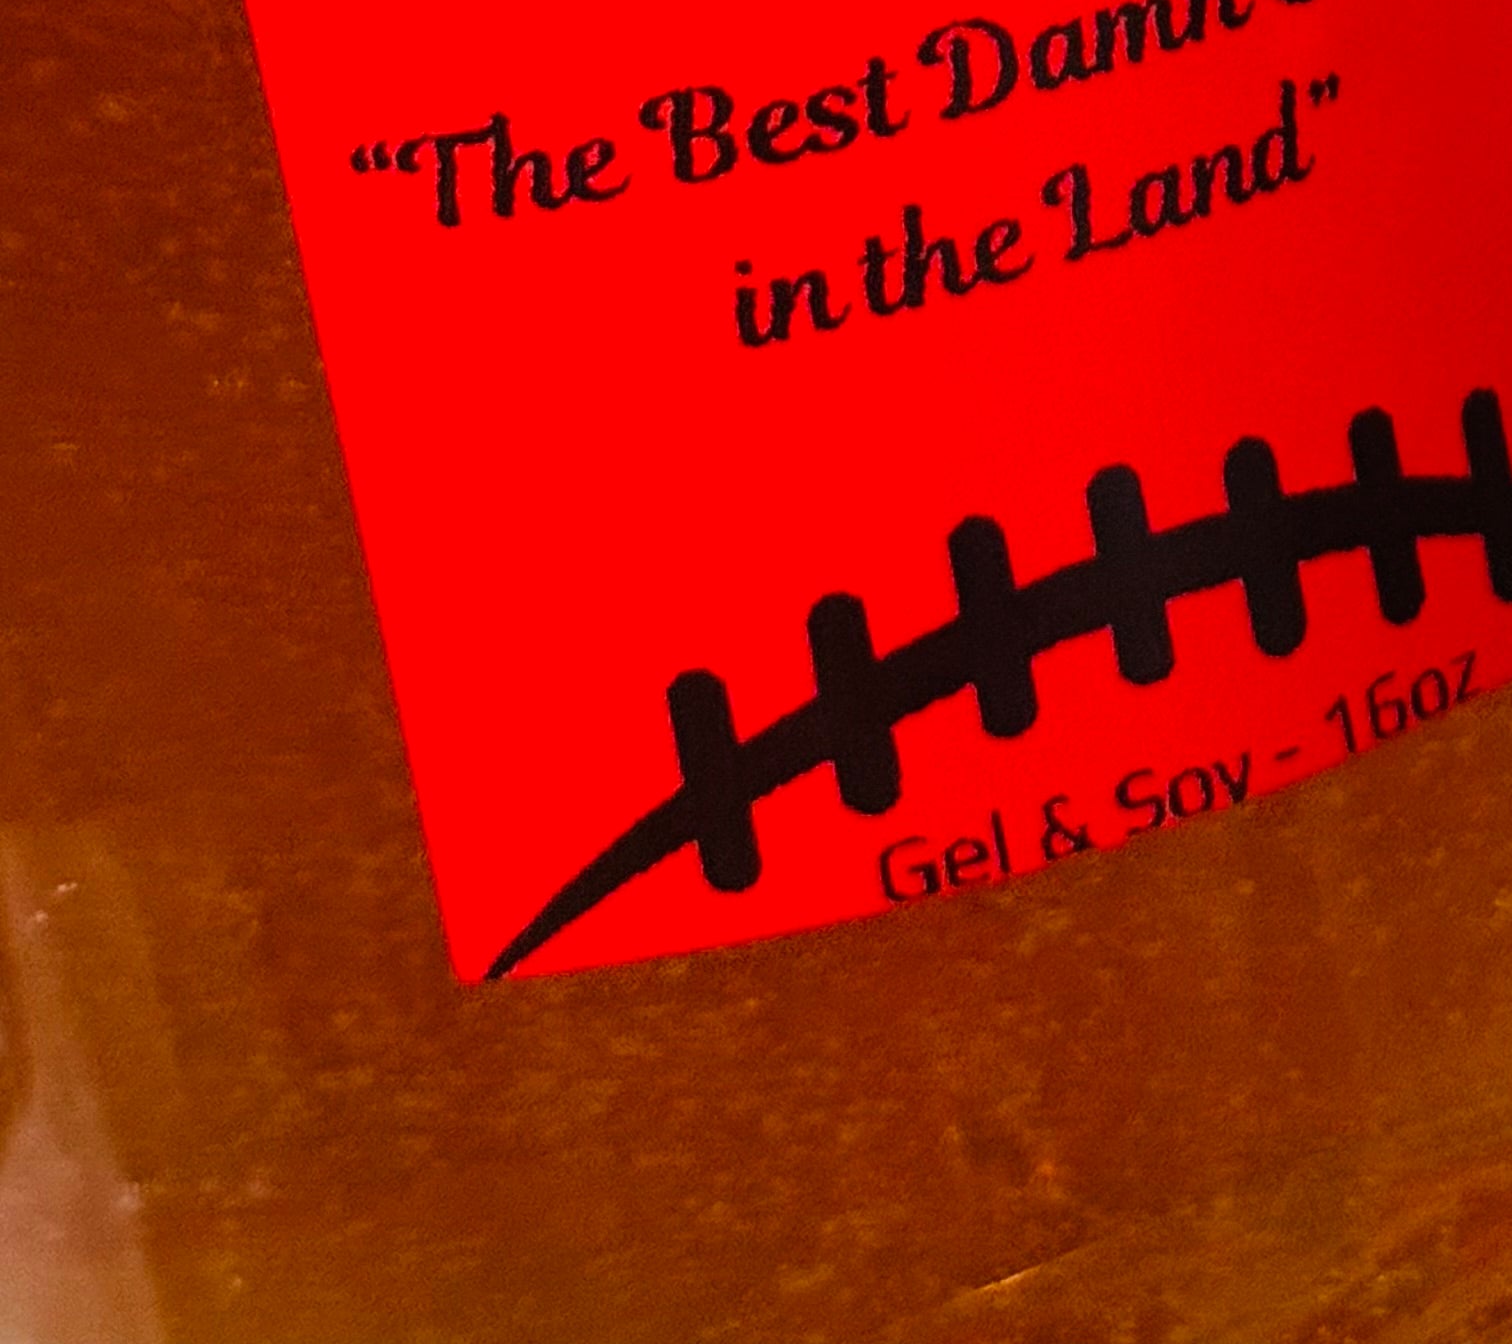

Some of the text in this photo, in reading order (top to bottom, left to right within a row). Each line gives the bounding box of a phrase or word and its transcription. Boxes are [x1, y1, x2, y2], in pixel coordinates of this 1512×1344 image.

[349, 113, 629, 227] “The
[639, 58, 908, 183] Best
[734, 73, 1342, 348] in the Land”
[878, 809, 1011, 904] Gel
[1041, 794, 1092, 862] &
[1324, 649, 1483, 757] 16oz
